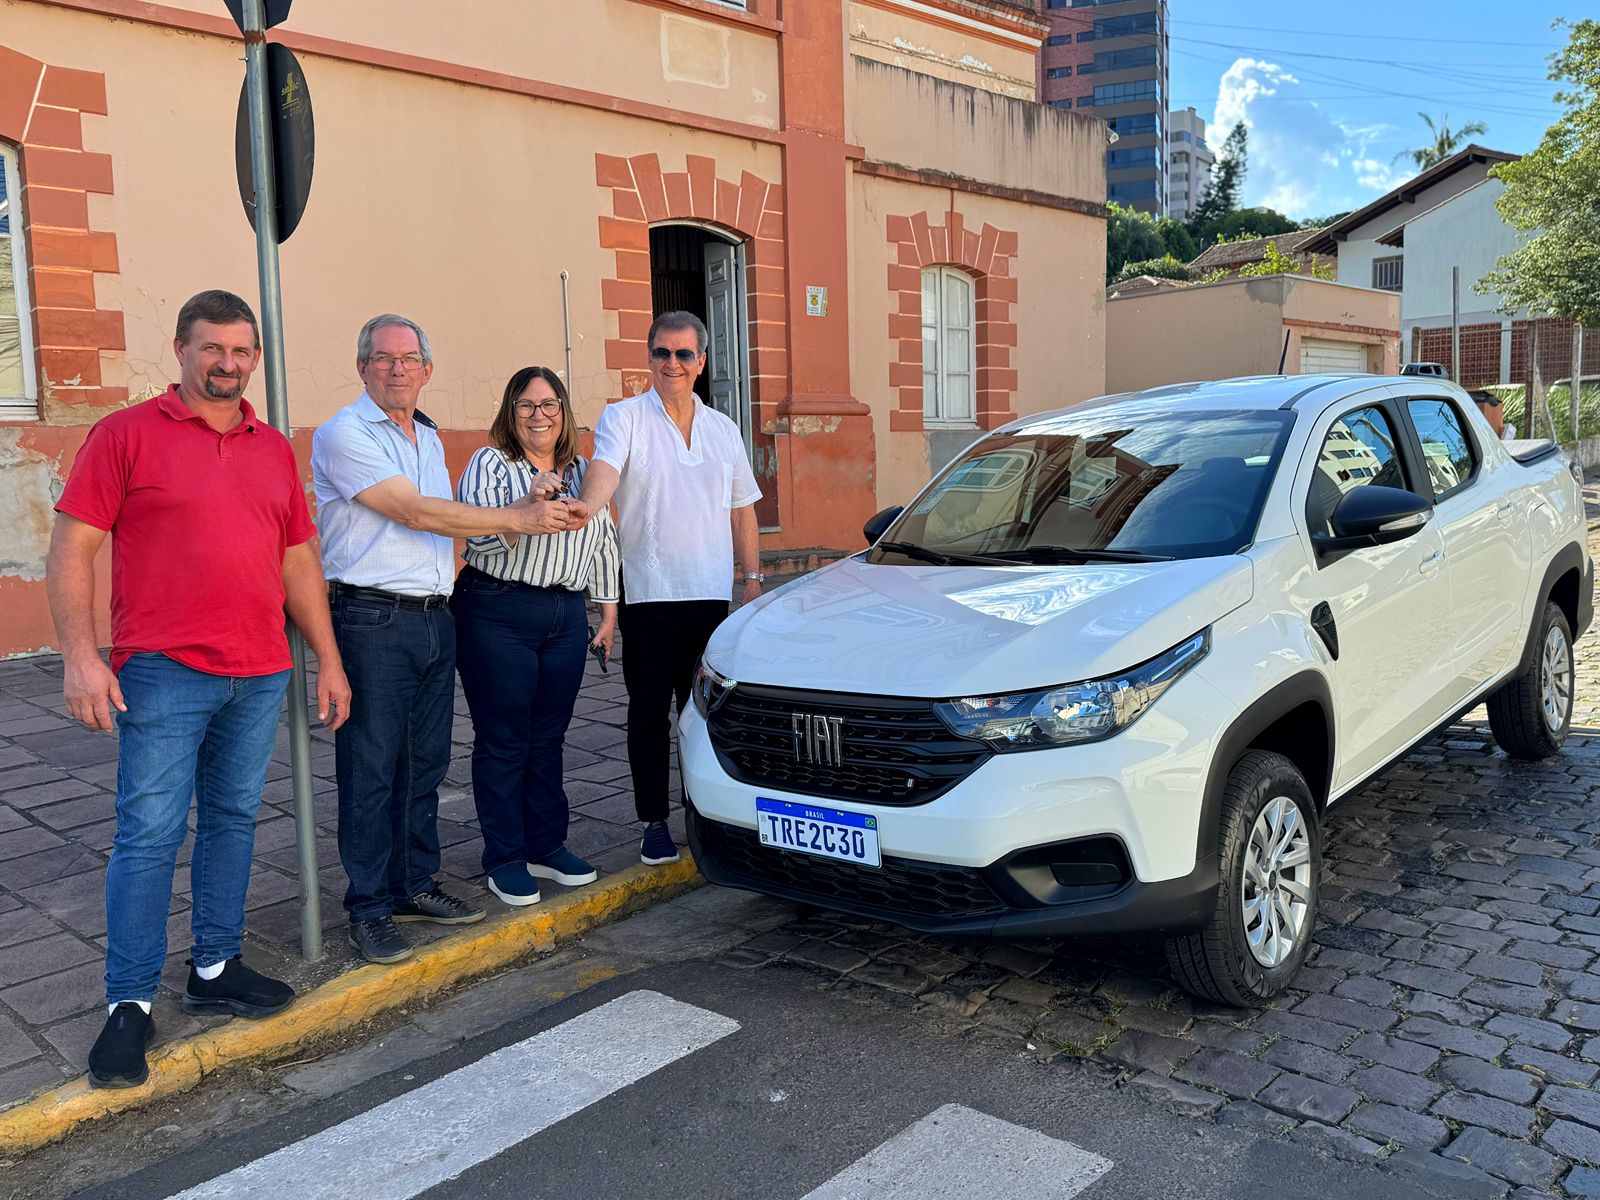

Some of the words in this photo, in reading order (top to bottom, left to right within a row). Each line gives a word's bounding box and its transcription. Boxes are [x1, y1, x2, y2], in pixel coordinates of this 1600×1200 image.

[792, 713, 843, 767] FIAT
[805, 810, 825, 819] BRASIL
[768, 815, 866, 858] TRE2C30
